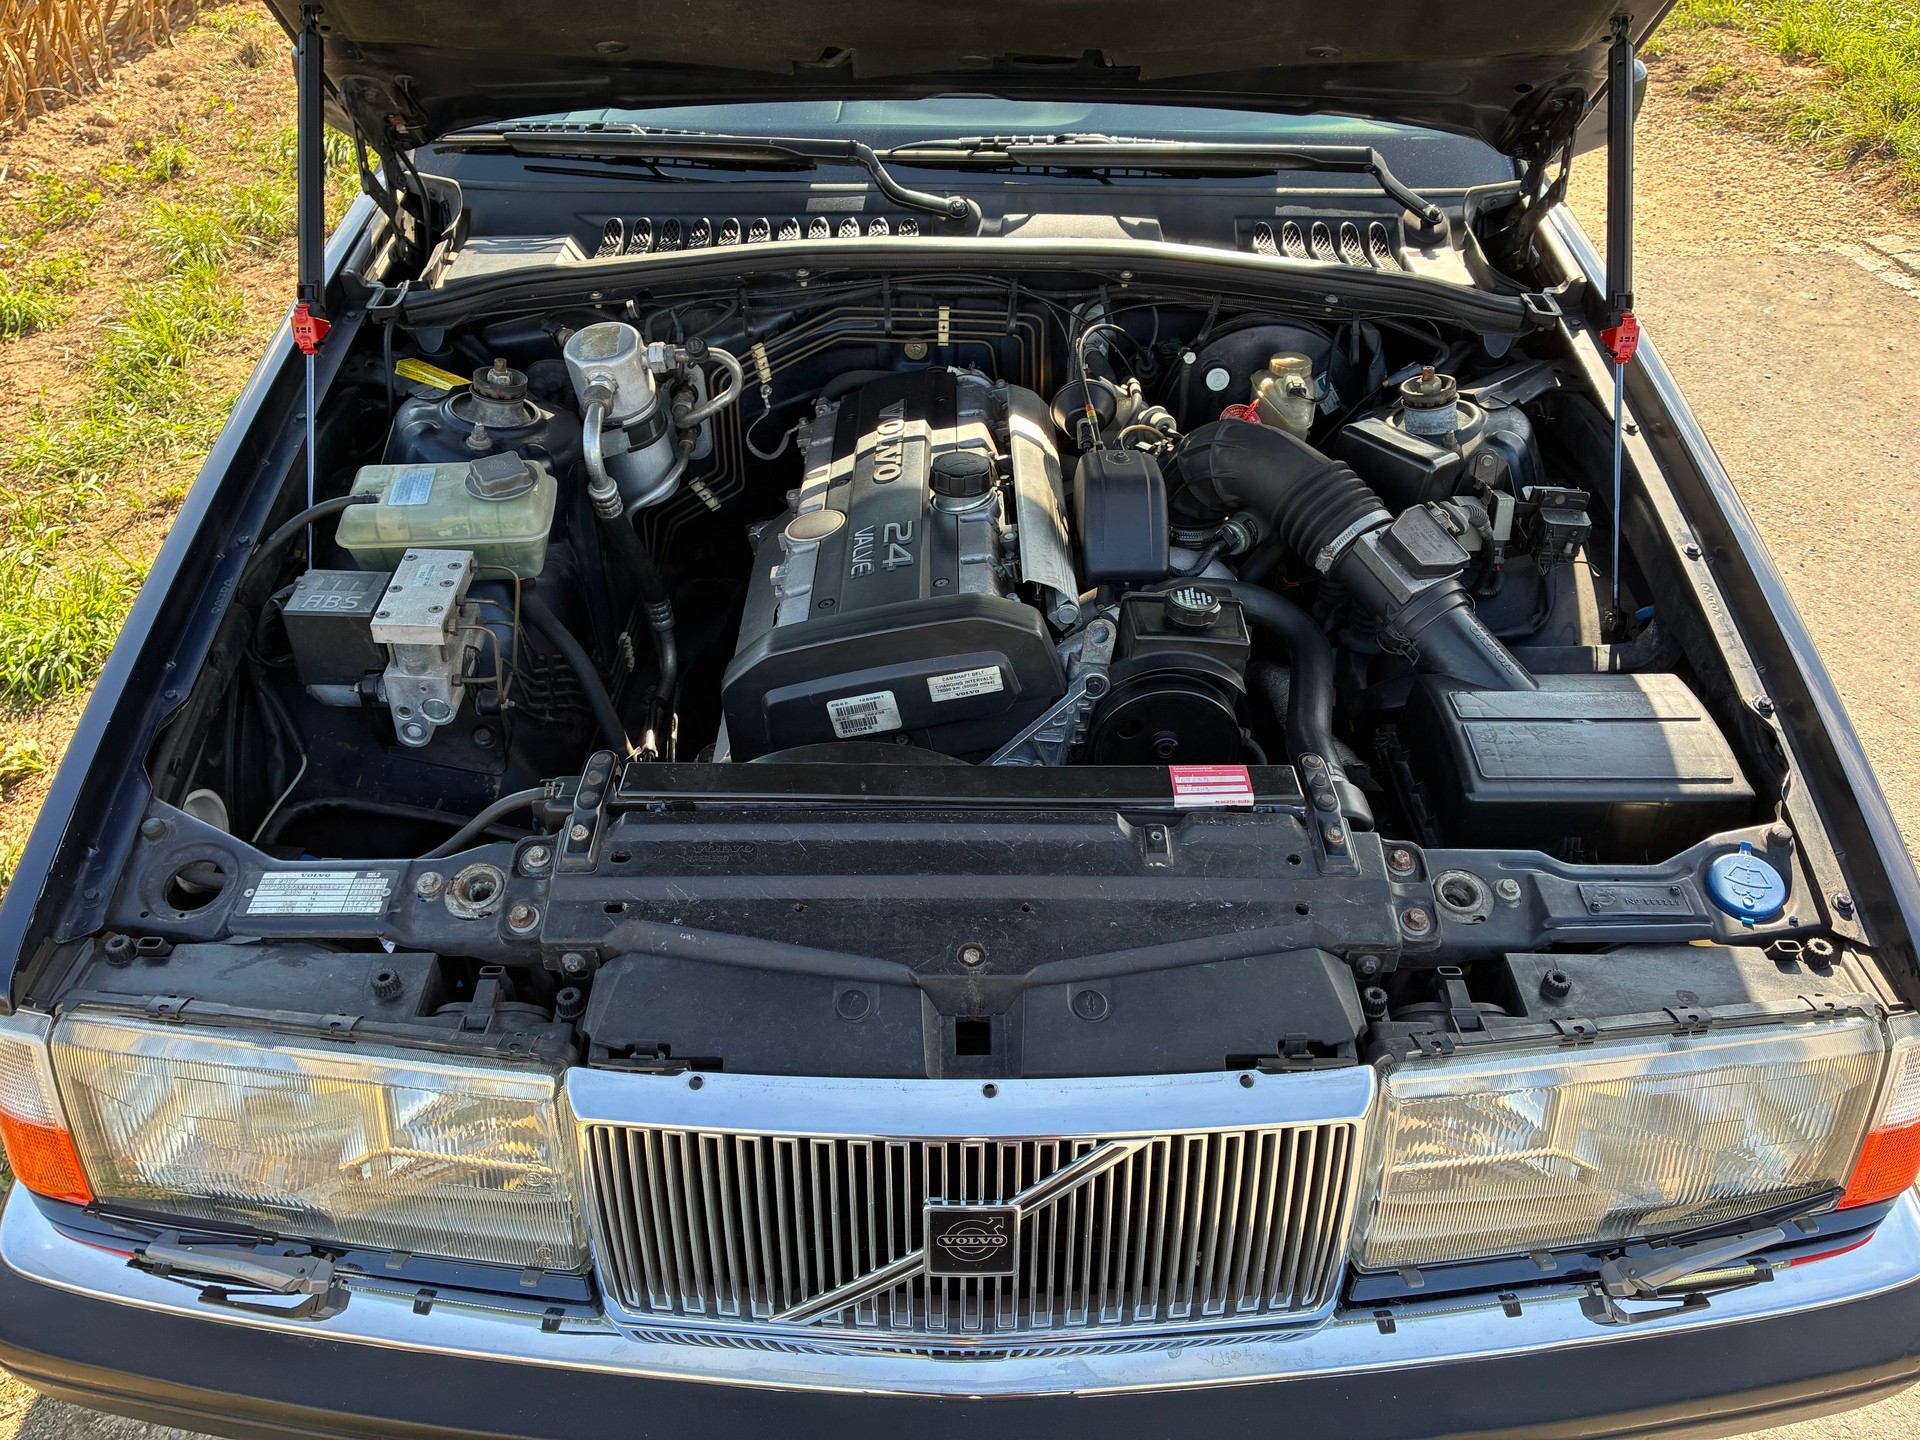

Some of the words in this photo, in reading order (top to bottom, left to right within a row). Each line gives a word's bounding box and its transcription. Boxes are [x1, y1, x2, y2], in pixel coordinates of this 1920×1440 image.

[873, 399, 905, 484] VOLVO
[851, 525, 875, 579] VALVE
[881, 521, 914, 571] 24
[301, 595, 363, 609] ABS
[1469, 626, 1514, 676] VOLVO
[942, 673, 971, 681] CAMSHAFT
[935, 681, 963, 689] CHANGING
[691, 845, 754, 853] VOLVO
[941, 1236, 1004, 1245] VOLVO
